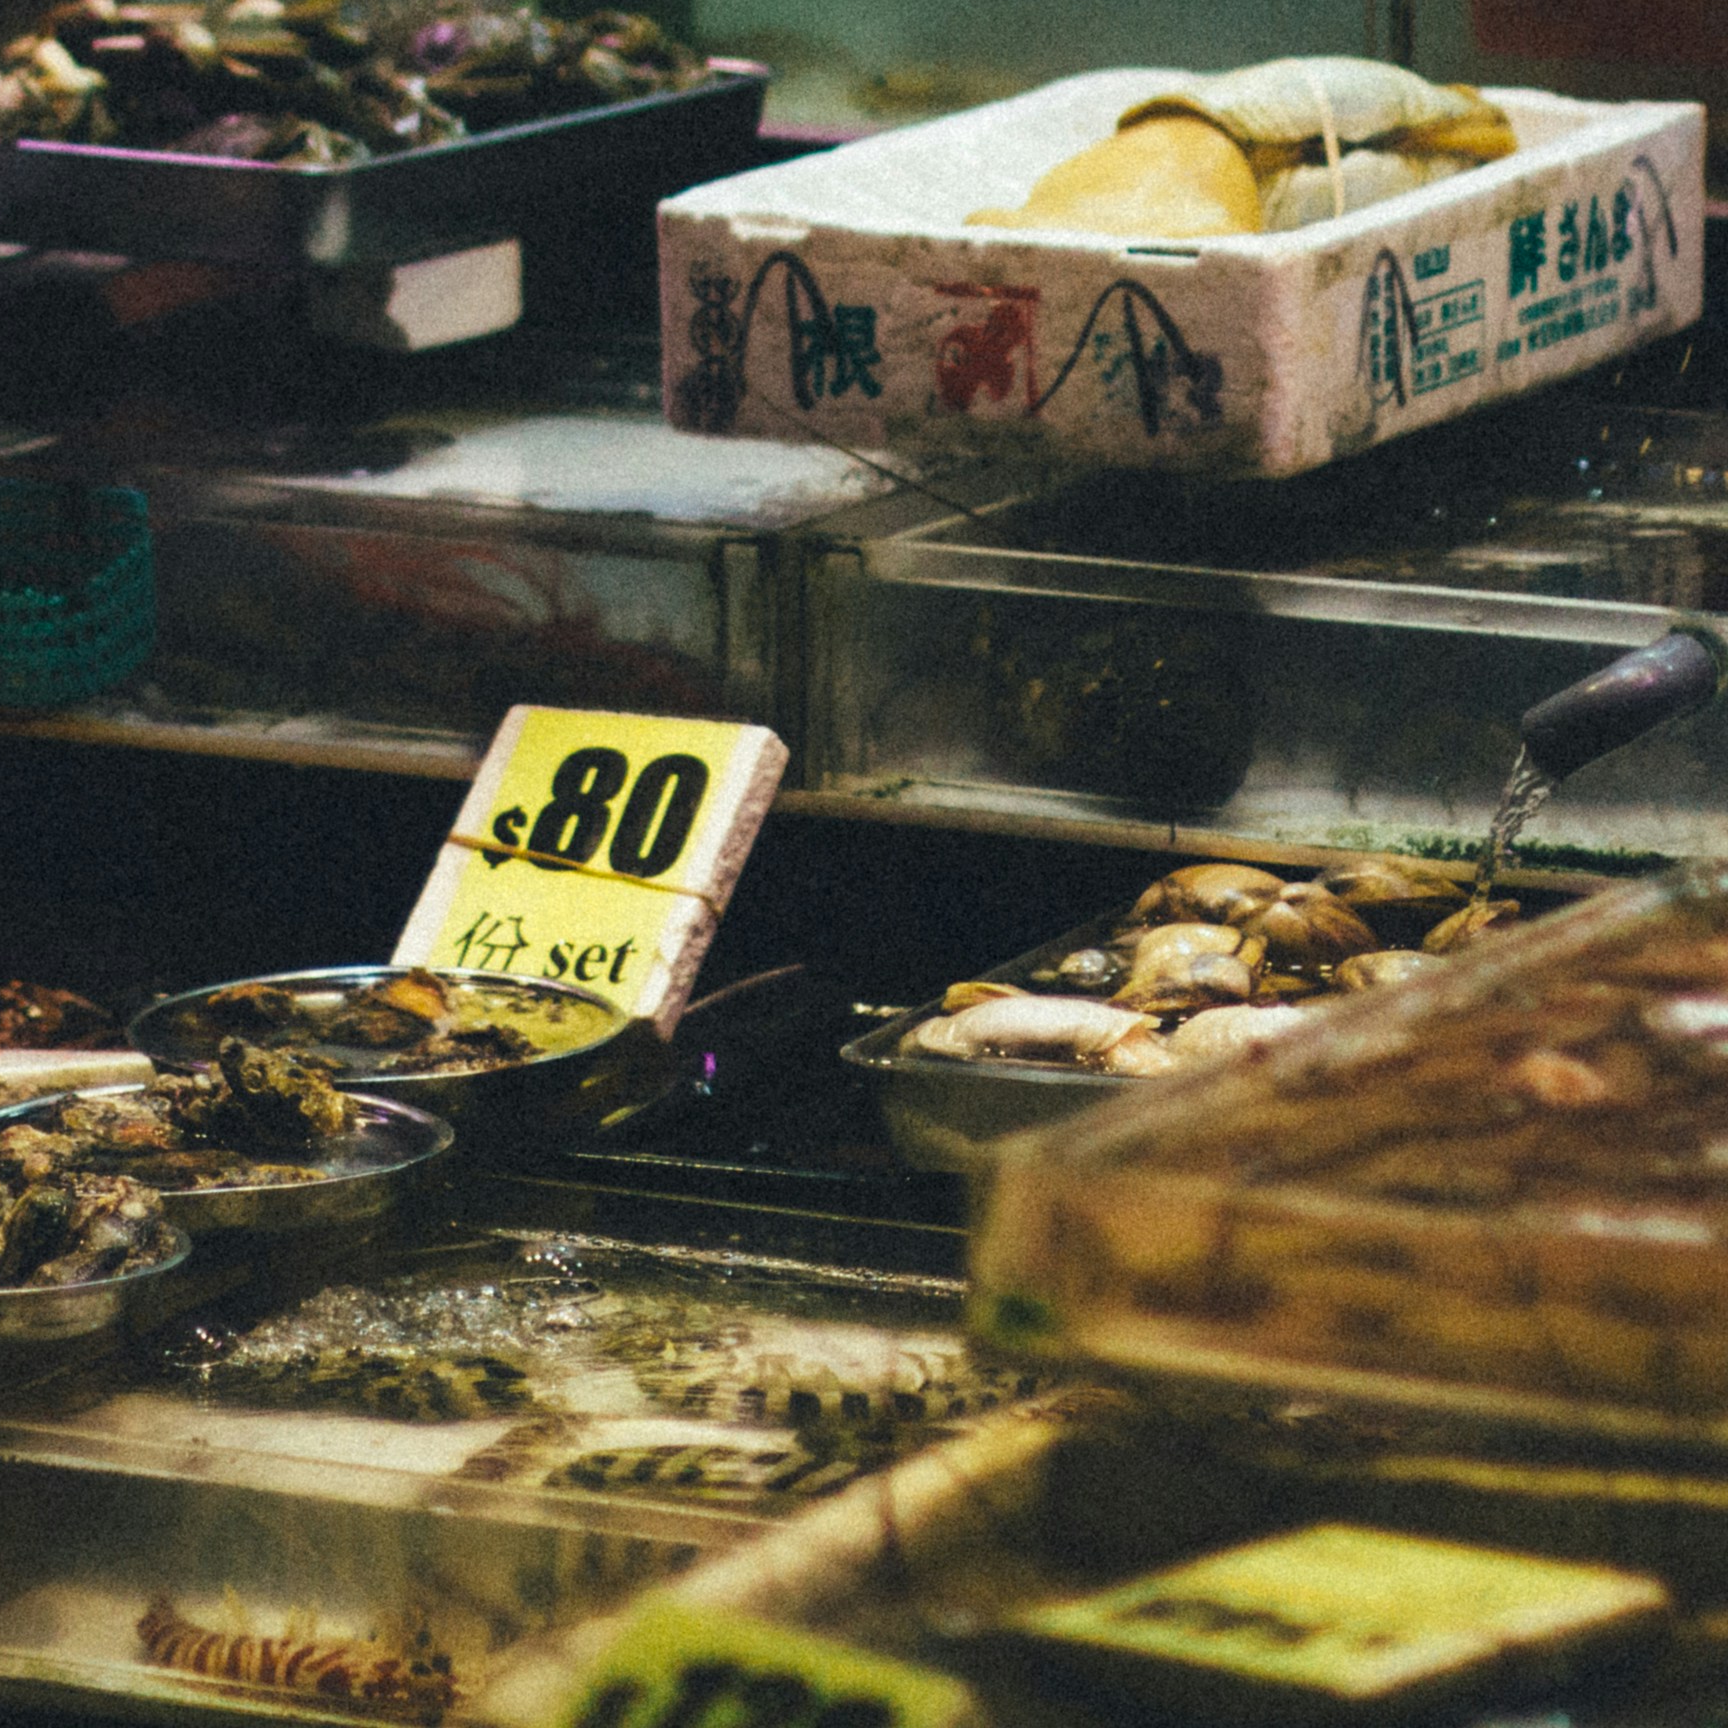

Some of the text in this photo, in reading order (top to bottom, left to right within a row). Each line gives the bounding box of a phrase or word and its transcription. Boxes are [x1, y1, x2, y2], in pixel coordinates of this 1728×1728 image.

[481, 746, 709, 879] $80
[455, 911, 638, 984] 份 set
